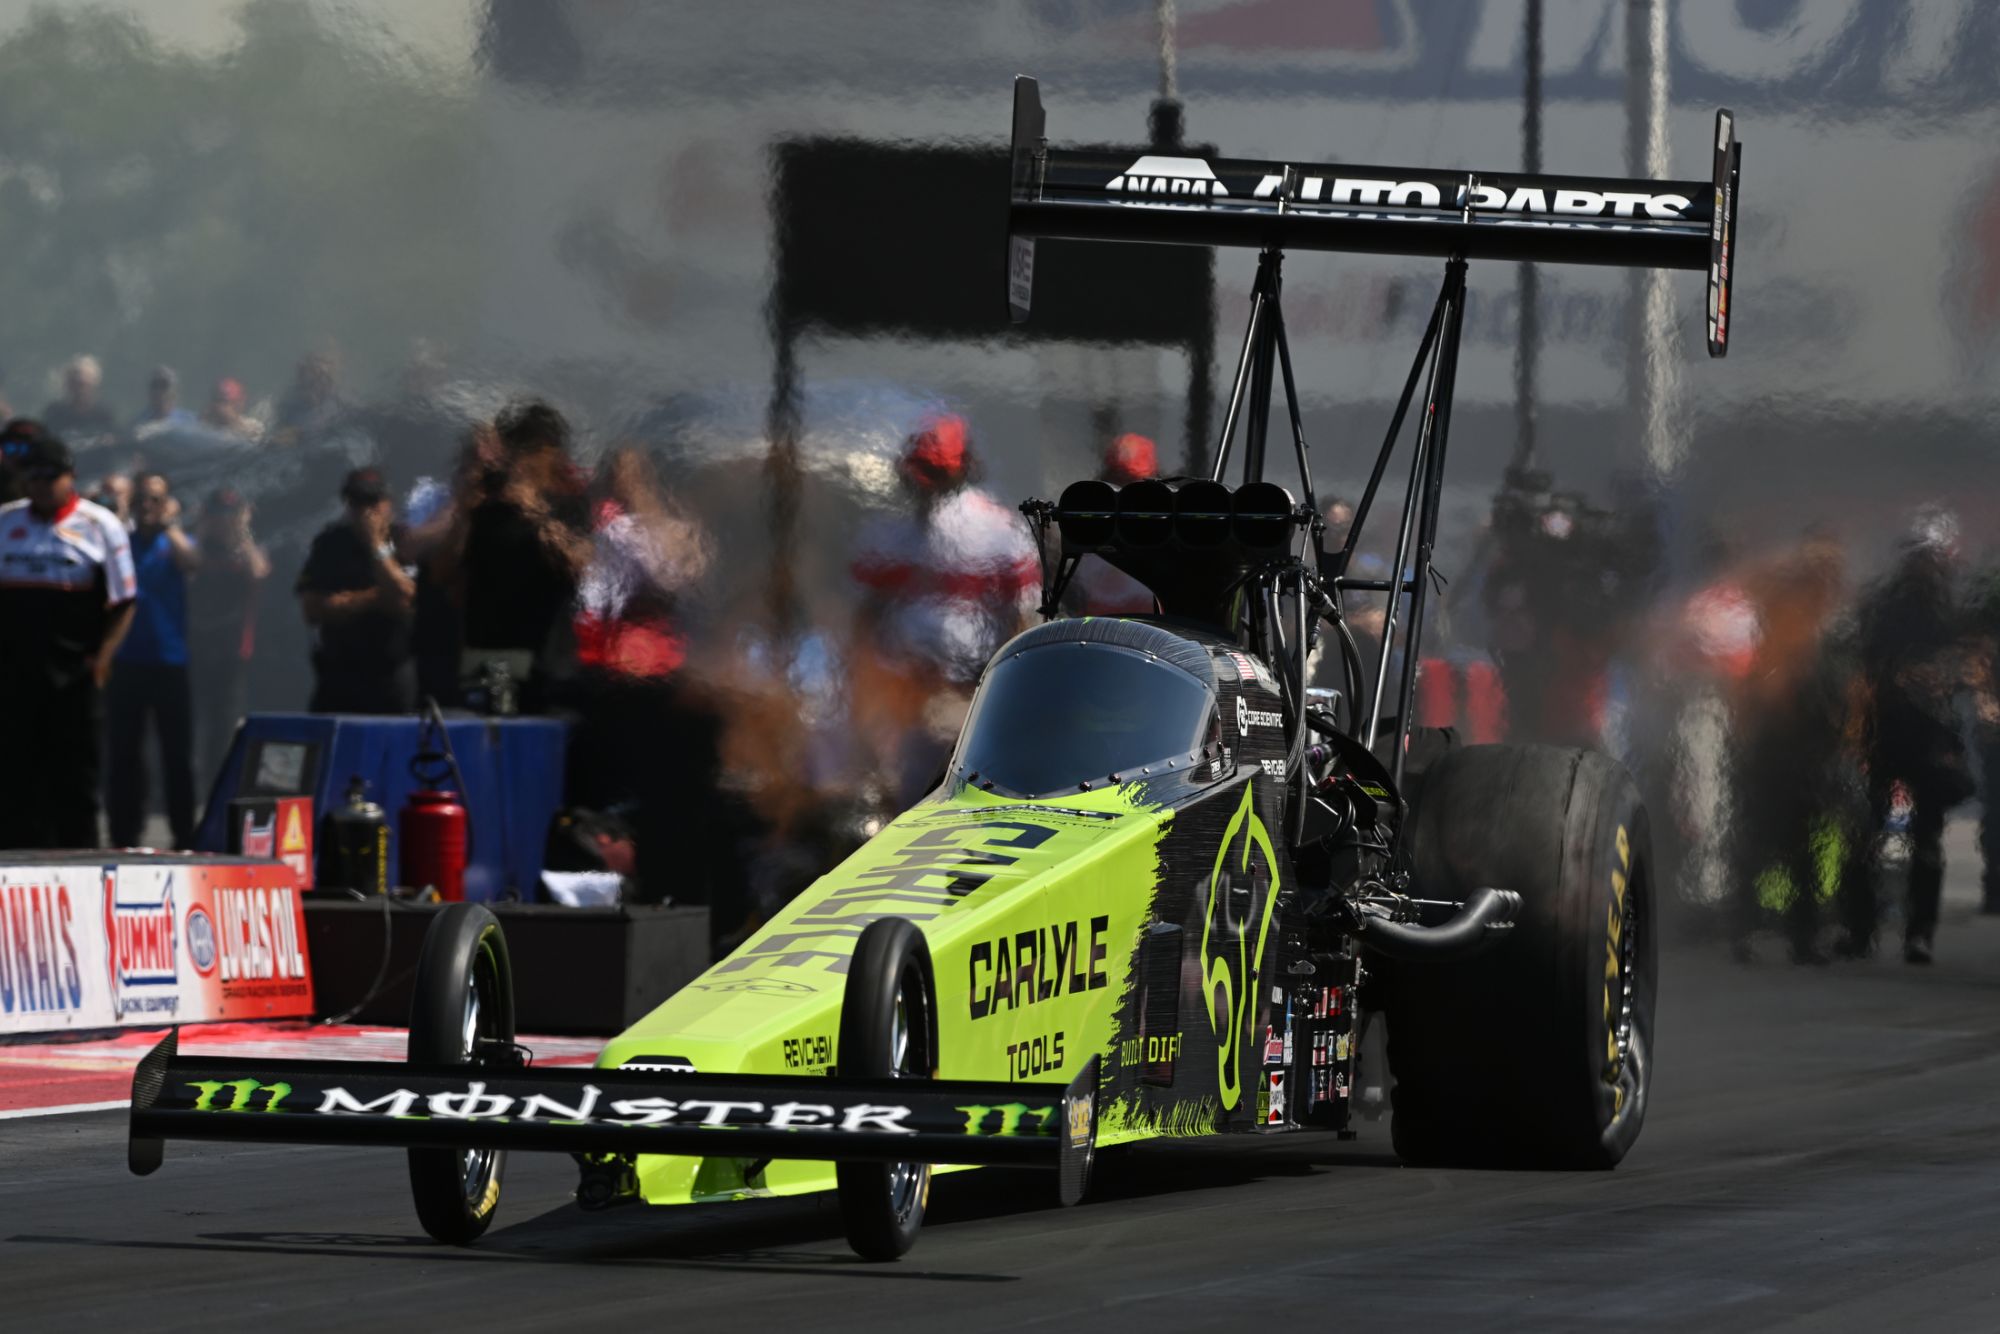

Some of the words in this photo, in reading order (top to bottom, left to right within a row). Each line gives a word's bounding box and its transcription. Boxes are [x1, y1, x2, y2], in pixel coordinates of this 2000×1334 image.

[213, 888, 274, 981] LUCAS
[270, 887, 305, 978] OIL
[969, 915, 1109, 1020] CARLYLE
[783, 1034, 832, 1068] REVCHEM
[1007, 1031, 1064, 1083] TOOLS
[1121, 1036, 1144, 1067] BUILT
